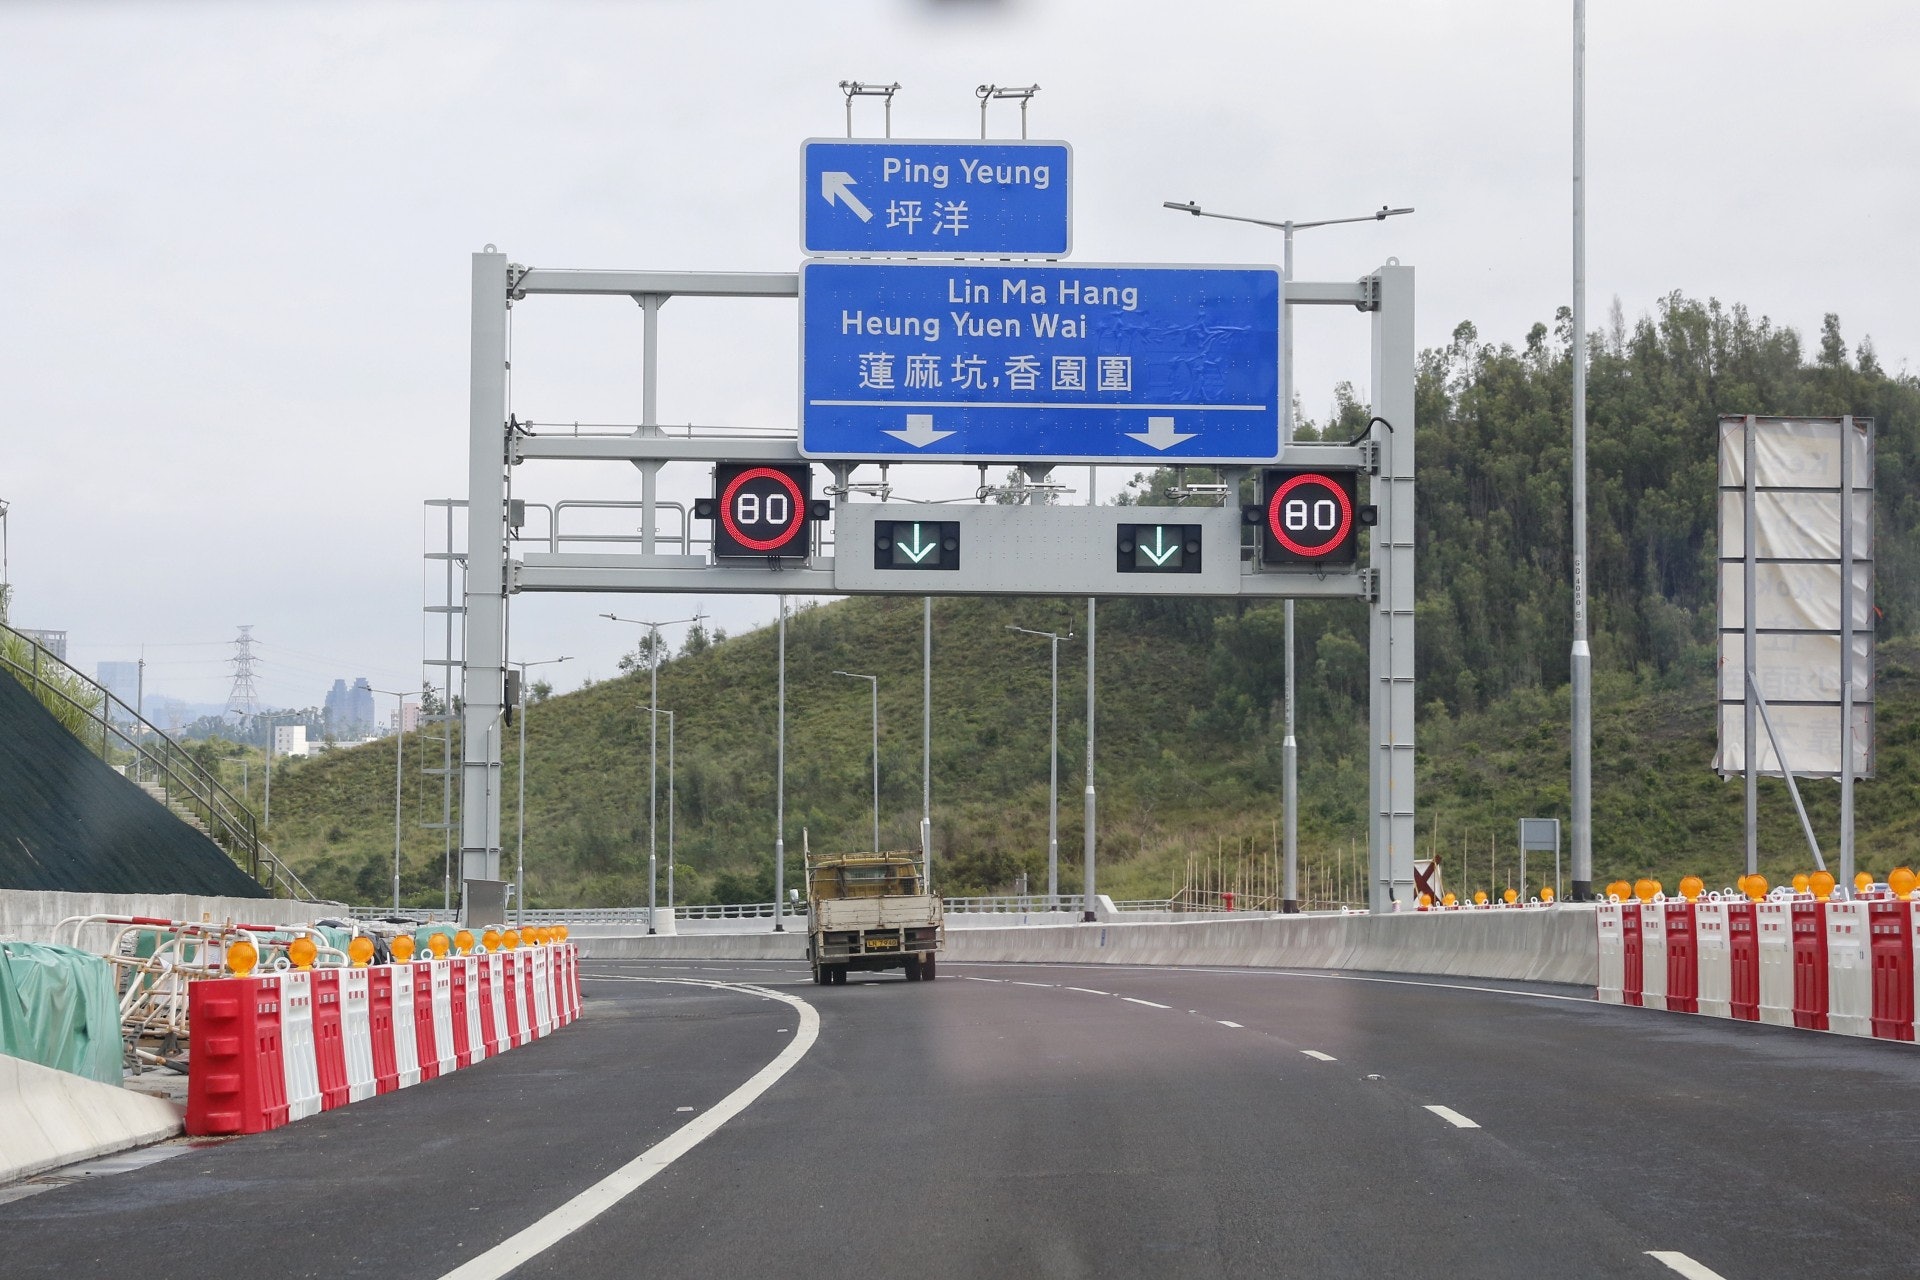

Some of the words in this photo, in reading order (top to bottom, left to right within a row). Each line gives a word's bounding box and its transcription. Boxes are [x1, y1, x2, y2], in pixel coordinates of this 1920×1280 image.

[883, 157, 949, 189] Ping
[959, 158, 1050, 190] Yeung
[885, 199, 969, 237] 坪洋
[949, 278, 989, 304] Lin
[1002, 278, 1047, 304] Ma
[1059, 279, 1138, 311] Hang
[842, 310, 940, 342] Heung
[950, 311, 1021, 337] Yuen
[1031, 313, 1086, 339] Wai
[737, 493, 788, 525] 80
[1285, 499, 1336, 531] 80
